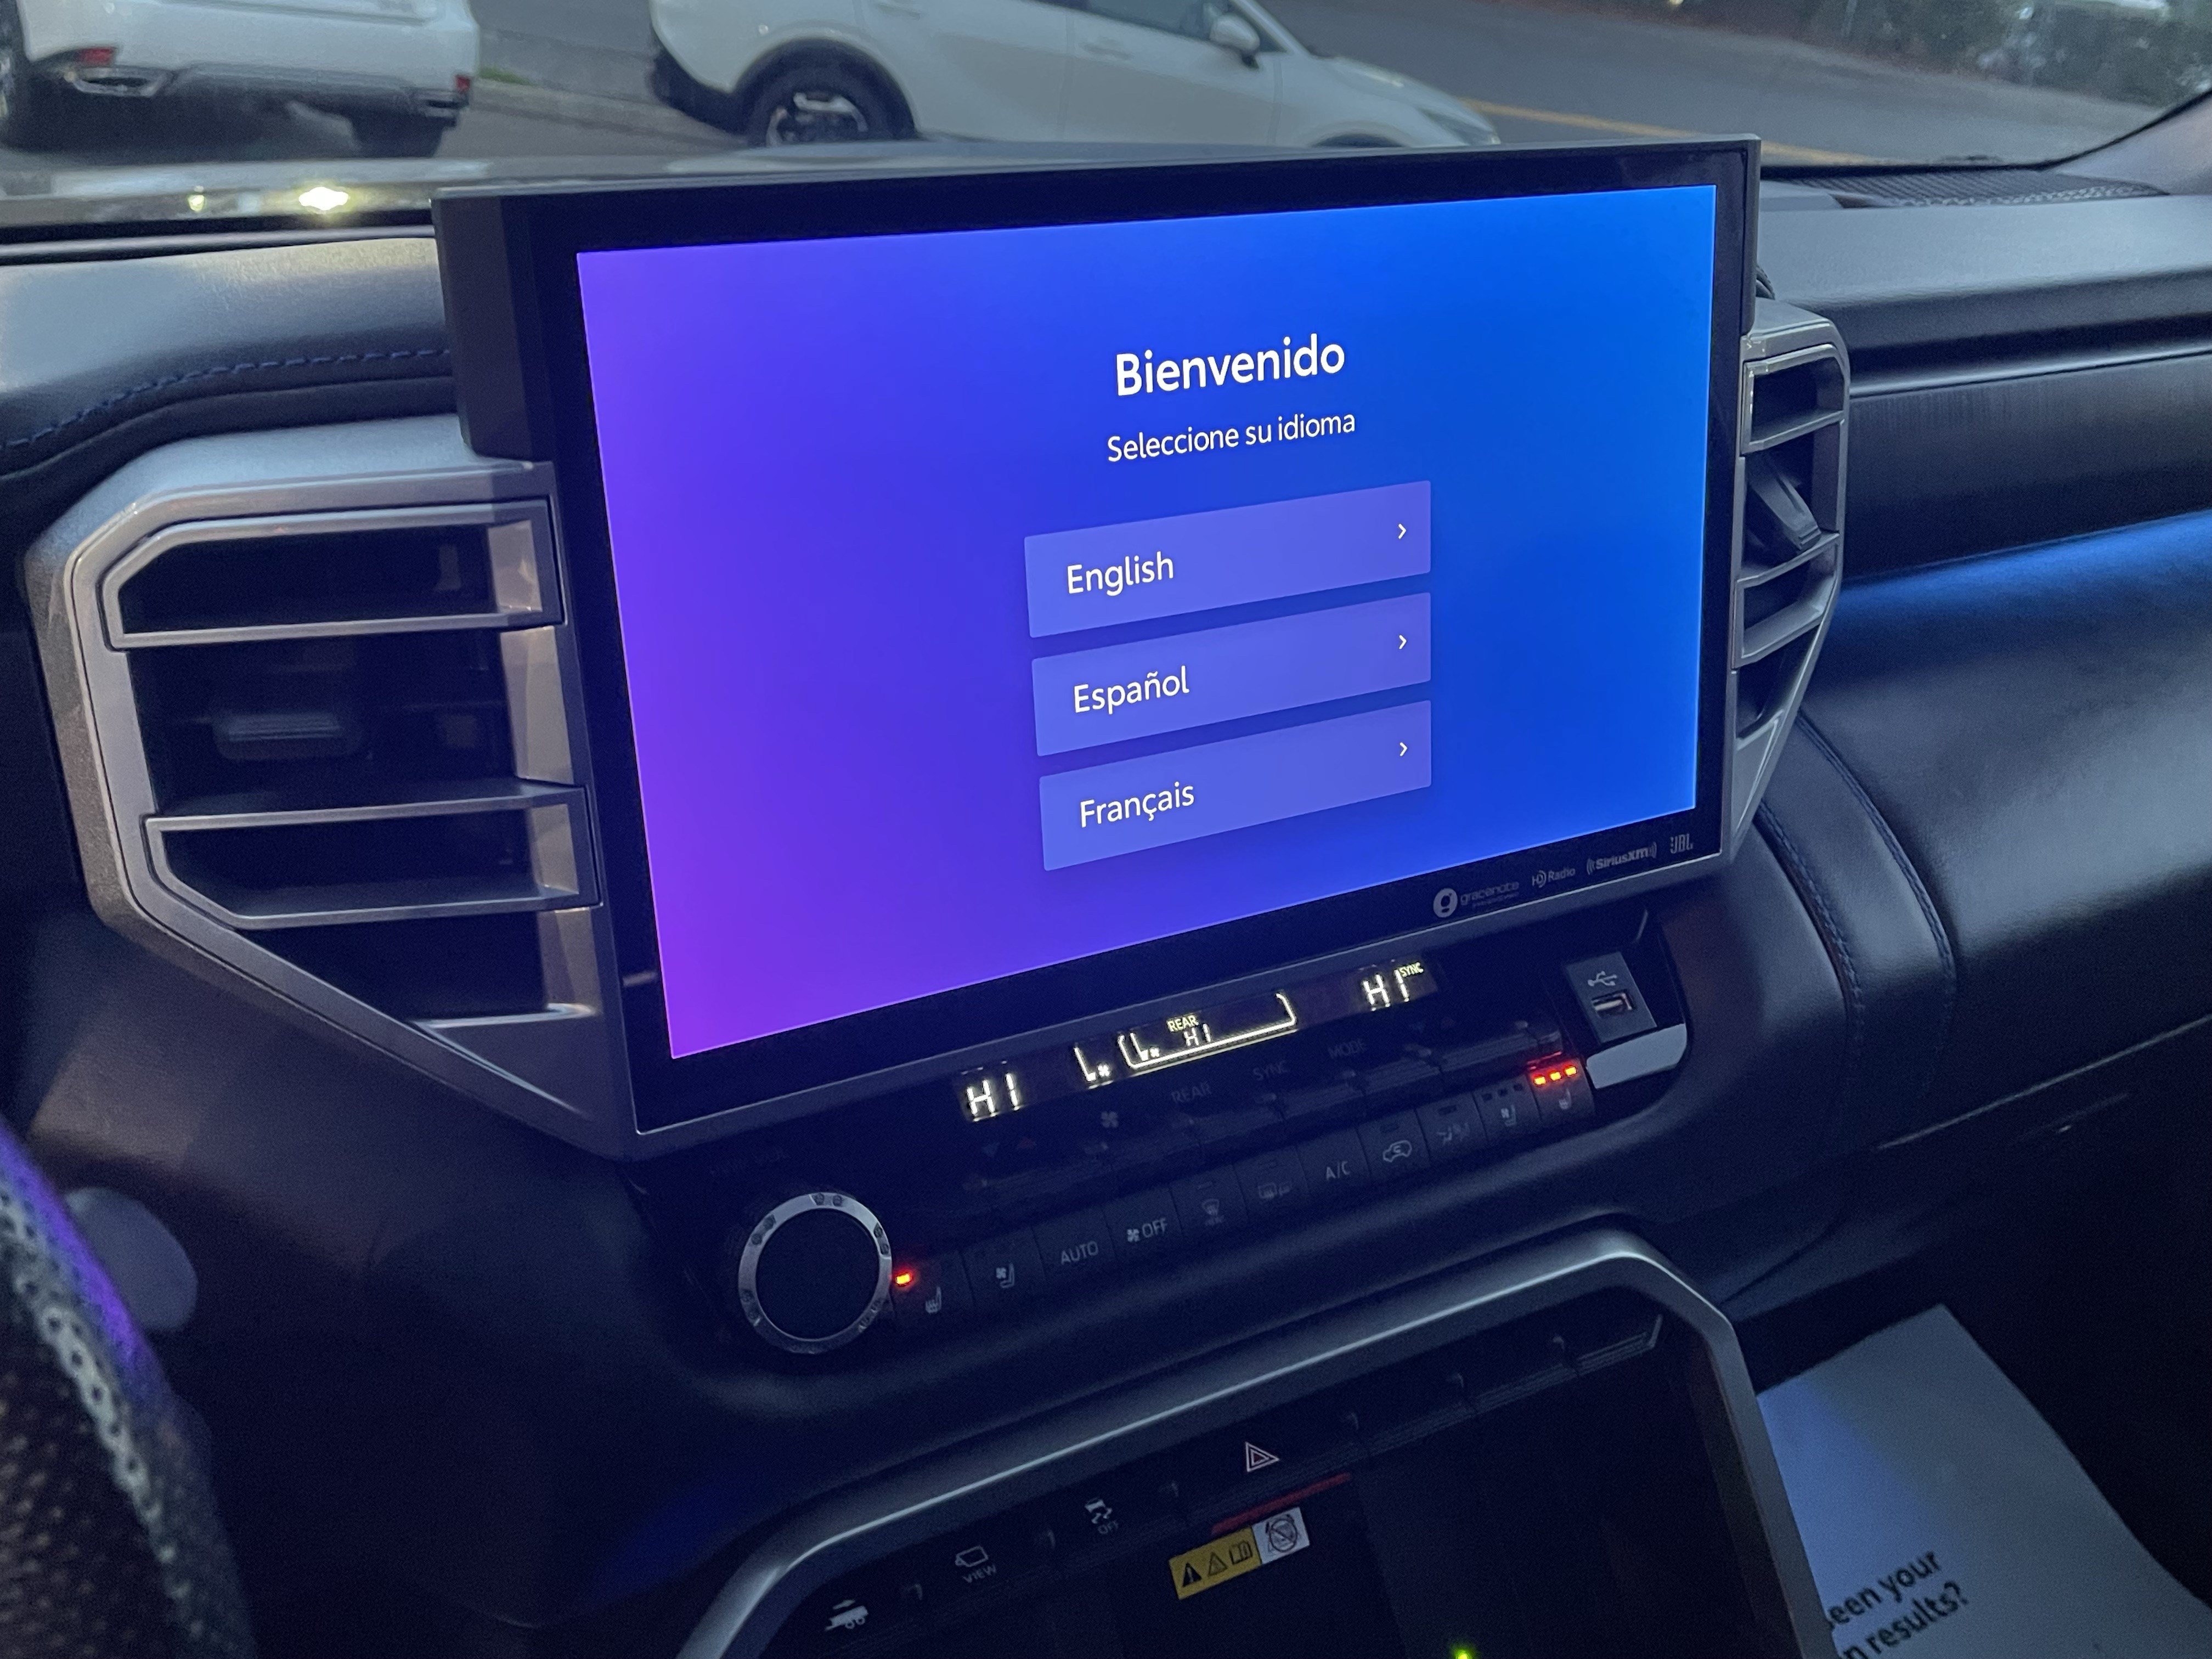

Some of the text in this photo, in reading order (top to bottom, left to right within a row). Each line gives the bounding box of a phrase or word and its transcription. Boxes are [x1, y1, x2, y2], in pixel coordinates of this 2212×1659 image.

[1116, 332, 1346, 397] Bienvenido
[1108, 413, 1356, 462] Seleccione su idioma
[1066, 551, 1175, 597] English
[1073, 665, 1190, 715] Español
[1080, 781, 1195, 828] Français
[1670, 833, 1694, 854] JBL
[1548, 867, 1576, 883] Radio
[1459, 882, 1520, 905] gracenote
[1400, 962, 1424, 978] SYNC
[1362, 969, 1409, 1006] HI
[1167, 1014, 1200, 1032] REAR
[1183, 1023, 1211, 1047] HI
[1328, 1038, 1368, 1059] MODE
[1252, 1059, 1290, 1082] SYNC
[966, 1072, 1020, 1116] HI
[1171, 1080, 1212, 1104] REAR
[1325, 1160, 1351, 1181] A/C
[1141, 1217, 1167, 1238] OFF
[1060, 1240, 1098, 1265] AUTO
[962, 1564, 997, 1583] VIEW
[1829, 1550, 1943, 1631] een your
[1865, 1580, 1970, 1655] results?
